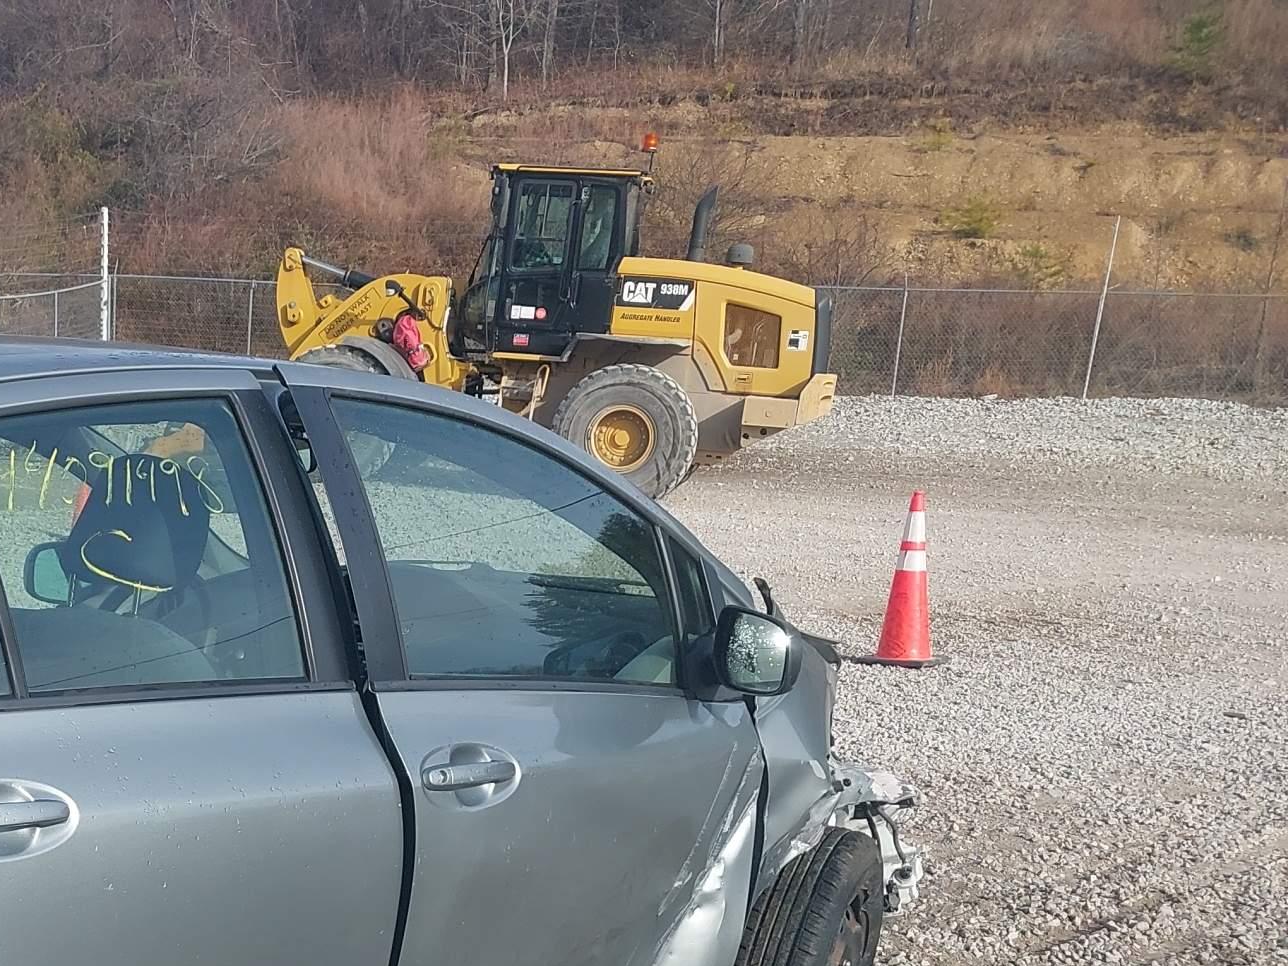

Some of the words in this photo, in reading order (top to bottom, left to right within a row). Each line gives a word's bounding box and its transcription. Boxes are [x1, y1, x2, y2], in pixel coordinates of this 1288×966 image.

[622, 281, 657, 304] CAT
[660, 283, 689, 296] 938M
[348, 293, 370, 313] WALK
[333, 317, 354, 337] UNDER
